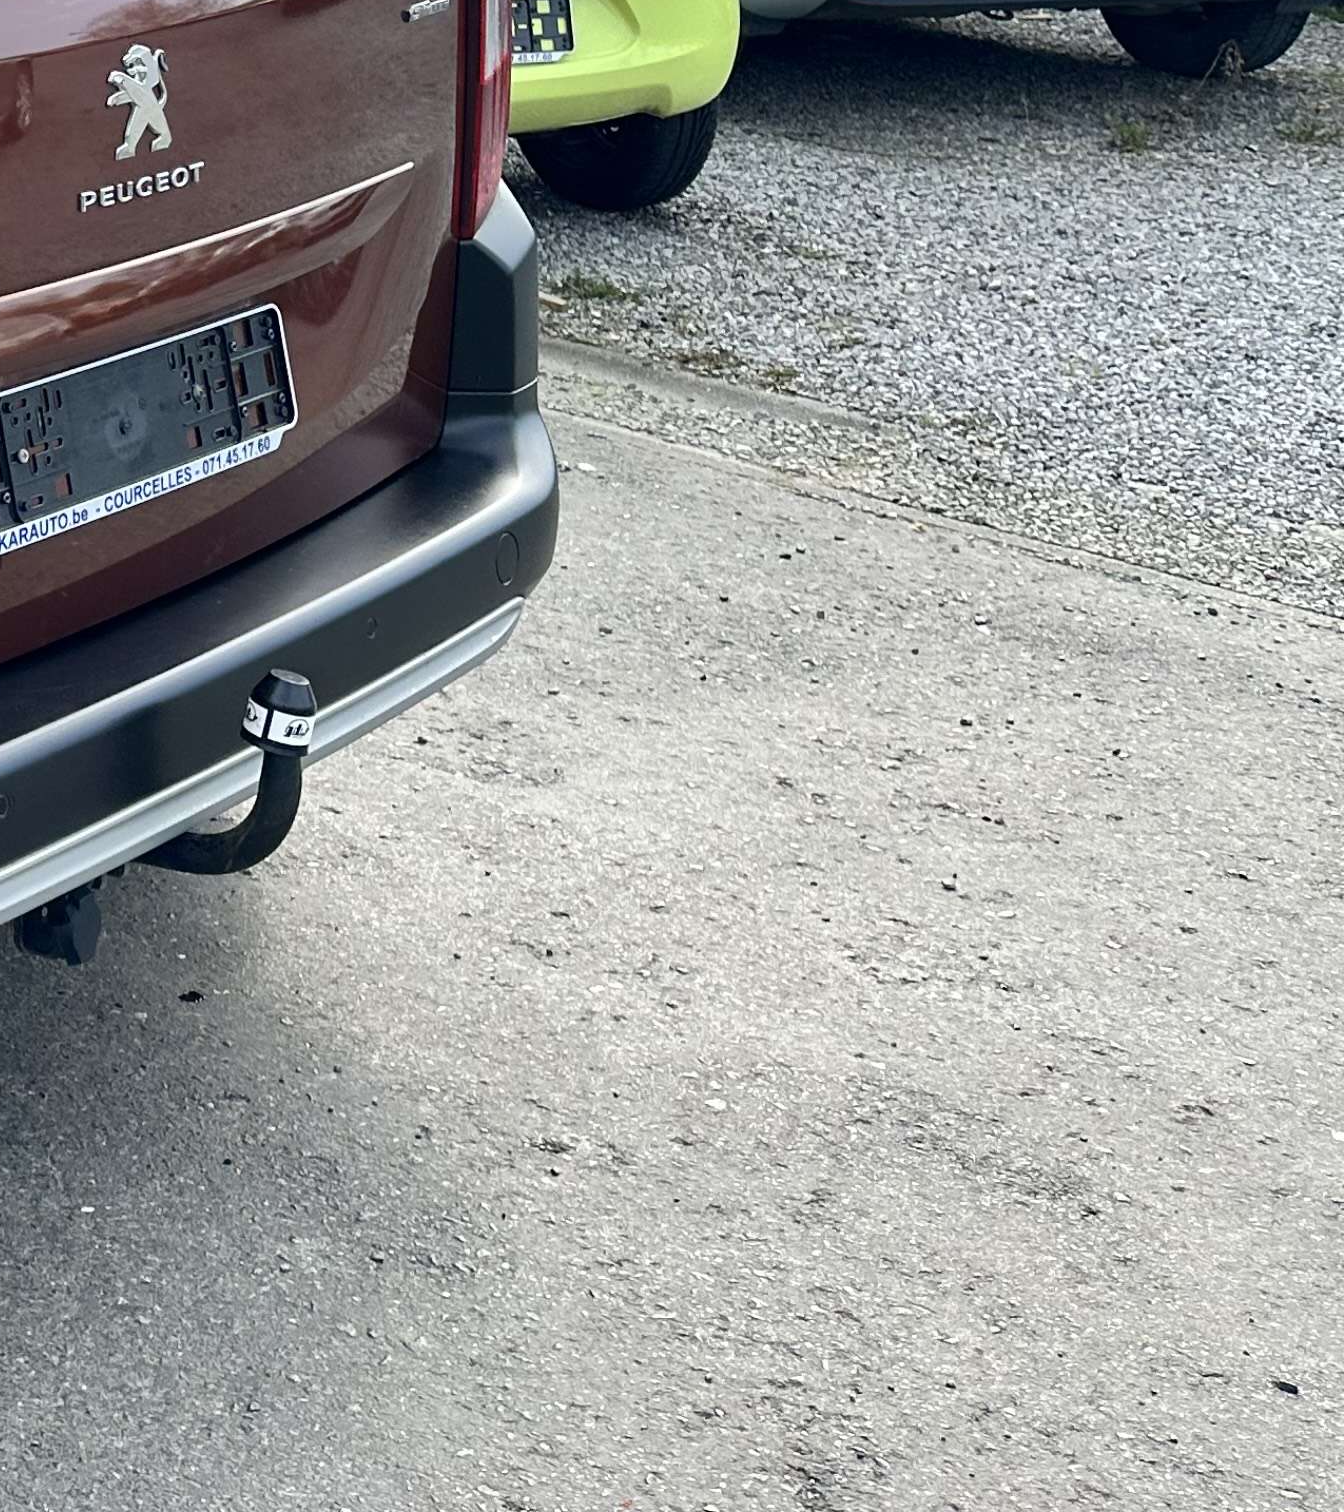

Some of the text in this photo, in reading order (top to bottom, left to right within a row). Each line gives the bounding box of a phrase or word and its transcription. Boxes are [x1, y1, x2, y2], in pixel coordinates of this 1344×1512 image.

[80, 161, 205, 213] PEUGEOT
[104, 466, 192, 513] COURCELLES
[202, 436, 271, 475] 071.45.17.60
